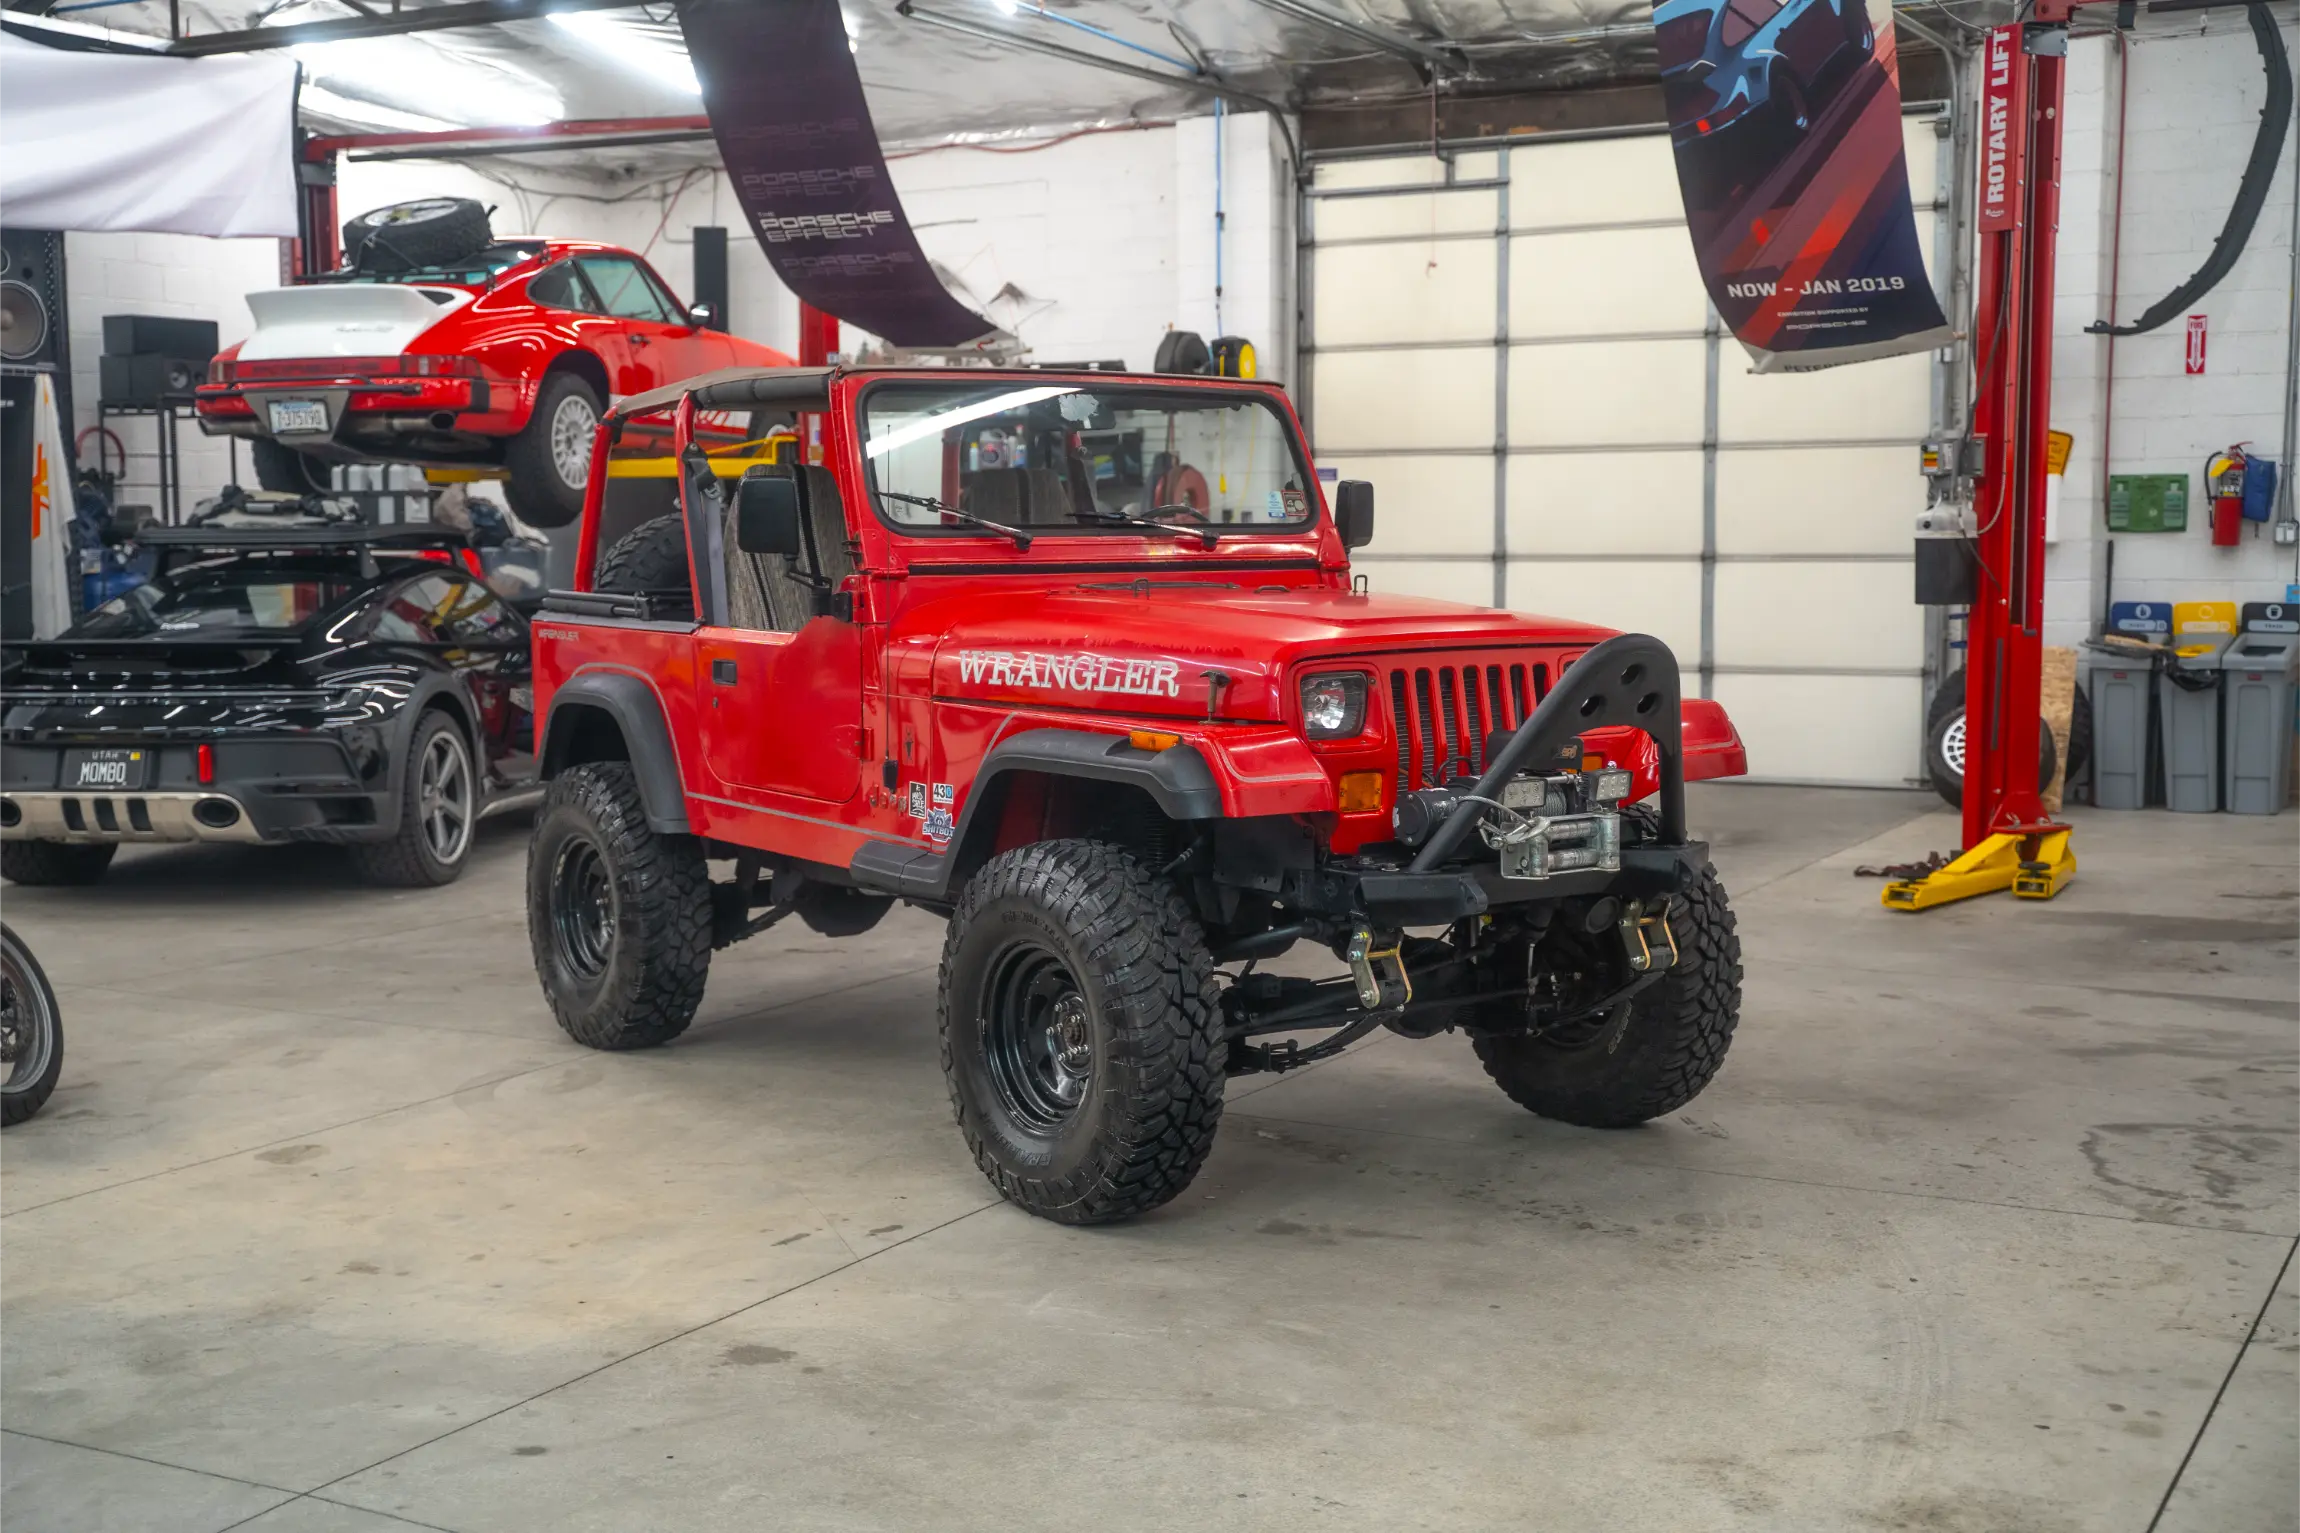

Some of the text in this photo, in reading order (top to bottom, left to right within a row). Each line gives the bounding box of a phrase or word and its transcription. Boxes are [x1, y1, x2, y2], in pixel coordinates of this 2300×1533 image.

[1991, 30, 2010, 87] LIFT
[1987, 95, 2008, 203] ROTARY
[742, 165, 876, 187] PORSCHE
[747, 180, 858, 200] EFFECT
[760, 210, 895, 231] PORSCHE
[765, 224, 877, 243] EFFECT
[780, 251, 914, 268] PORSCHE
[1727, 281, 1777, 299] NOW
[1799, 279, 1842, 296] JAN
[1846, 276, 1905, 293] 2019
[959, 649, 1180, 697] WRANGLER
[80, 762, 127, 783] MOMBO
